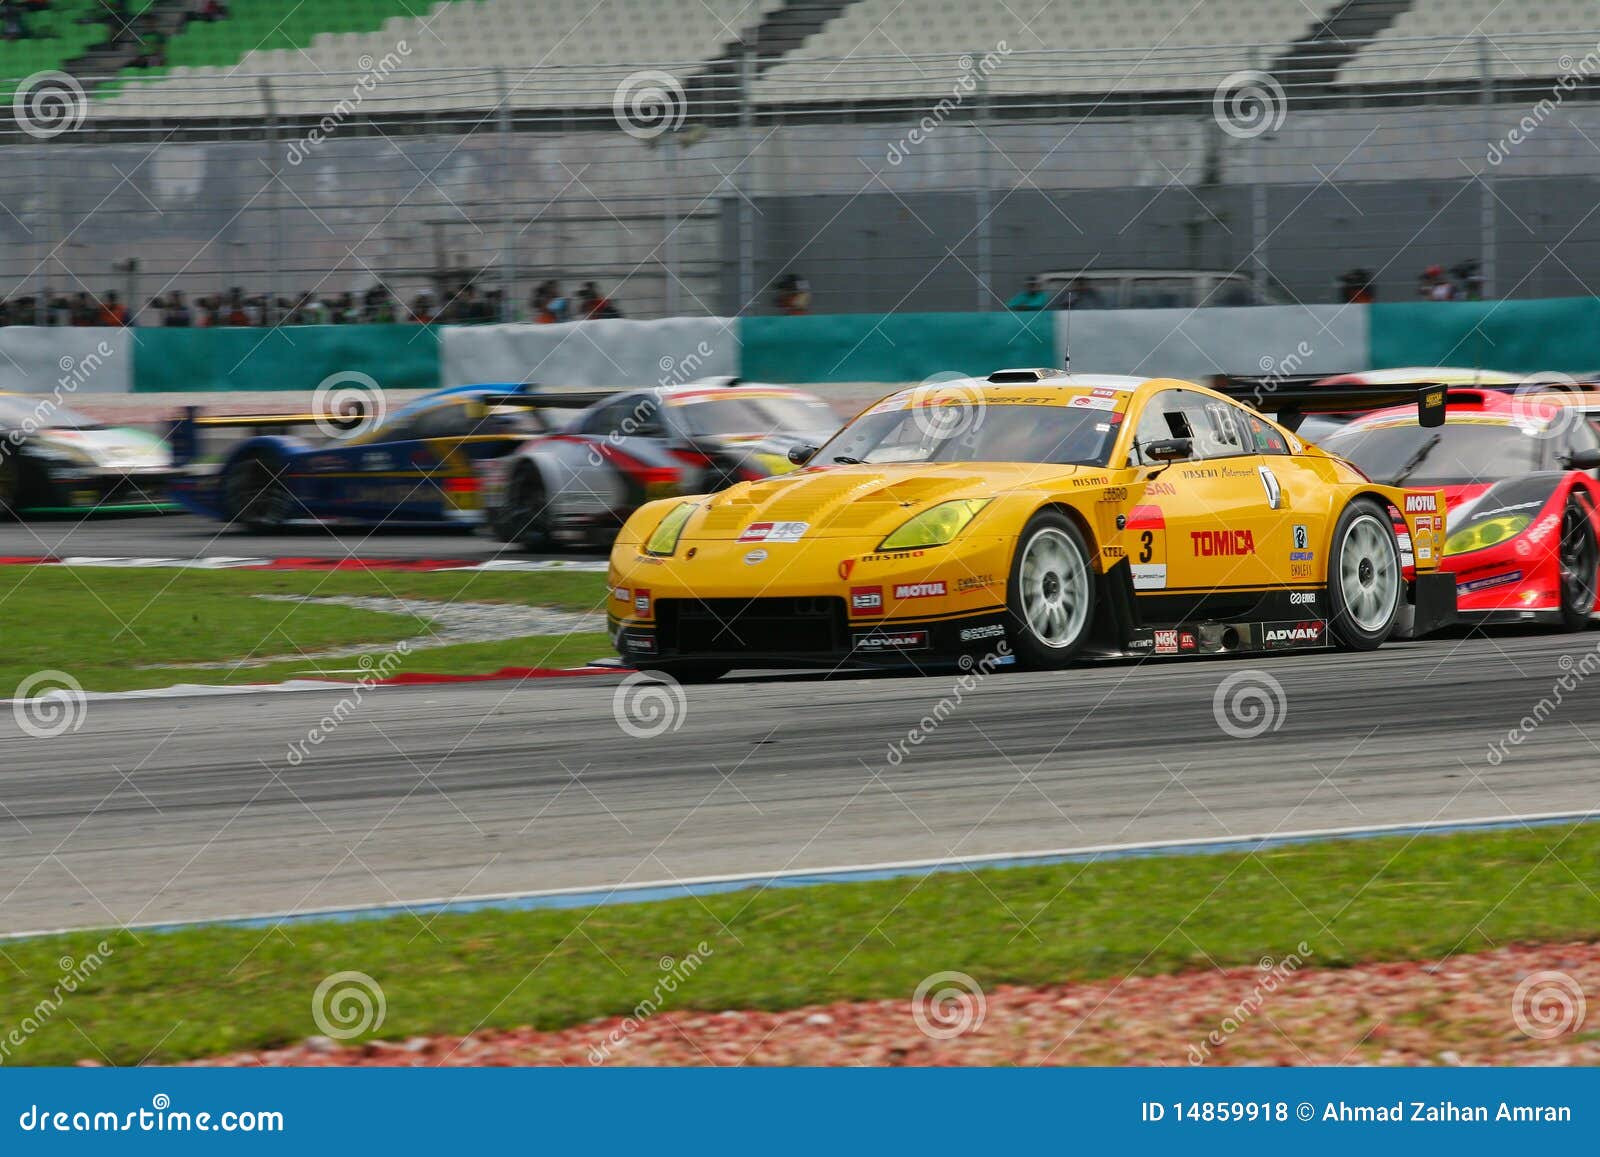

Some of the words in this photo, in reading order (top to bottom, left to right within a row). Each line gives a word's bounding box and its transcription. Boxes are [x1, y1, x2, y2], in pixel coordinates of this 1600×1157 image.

[1406, 495, 1437, 512] MOTUL
[1139, 530, 1153, 564] 3
[1190, 530, 1256, 557] TOMICA
[895, 582, 946, 598] MOTUL
[858, 637, 918, 646] ADVAN
[1155, 631, 1177, 647] NGK
[1265, 628, 1318, 642] ADVAN
